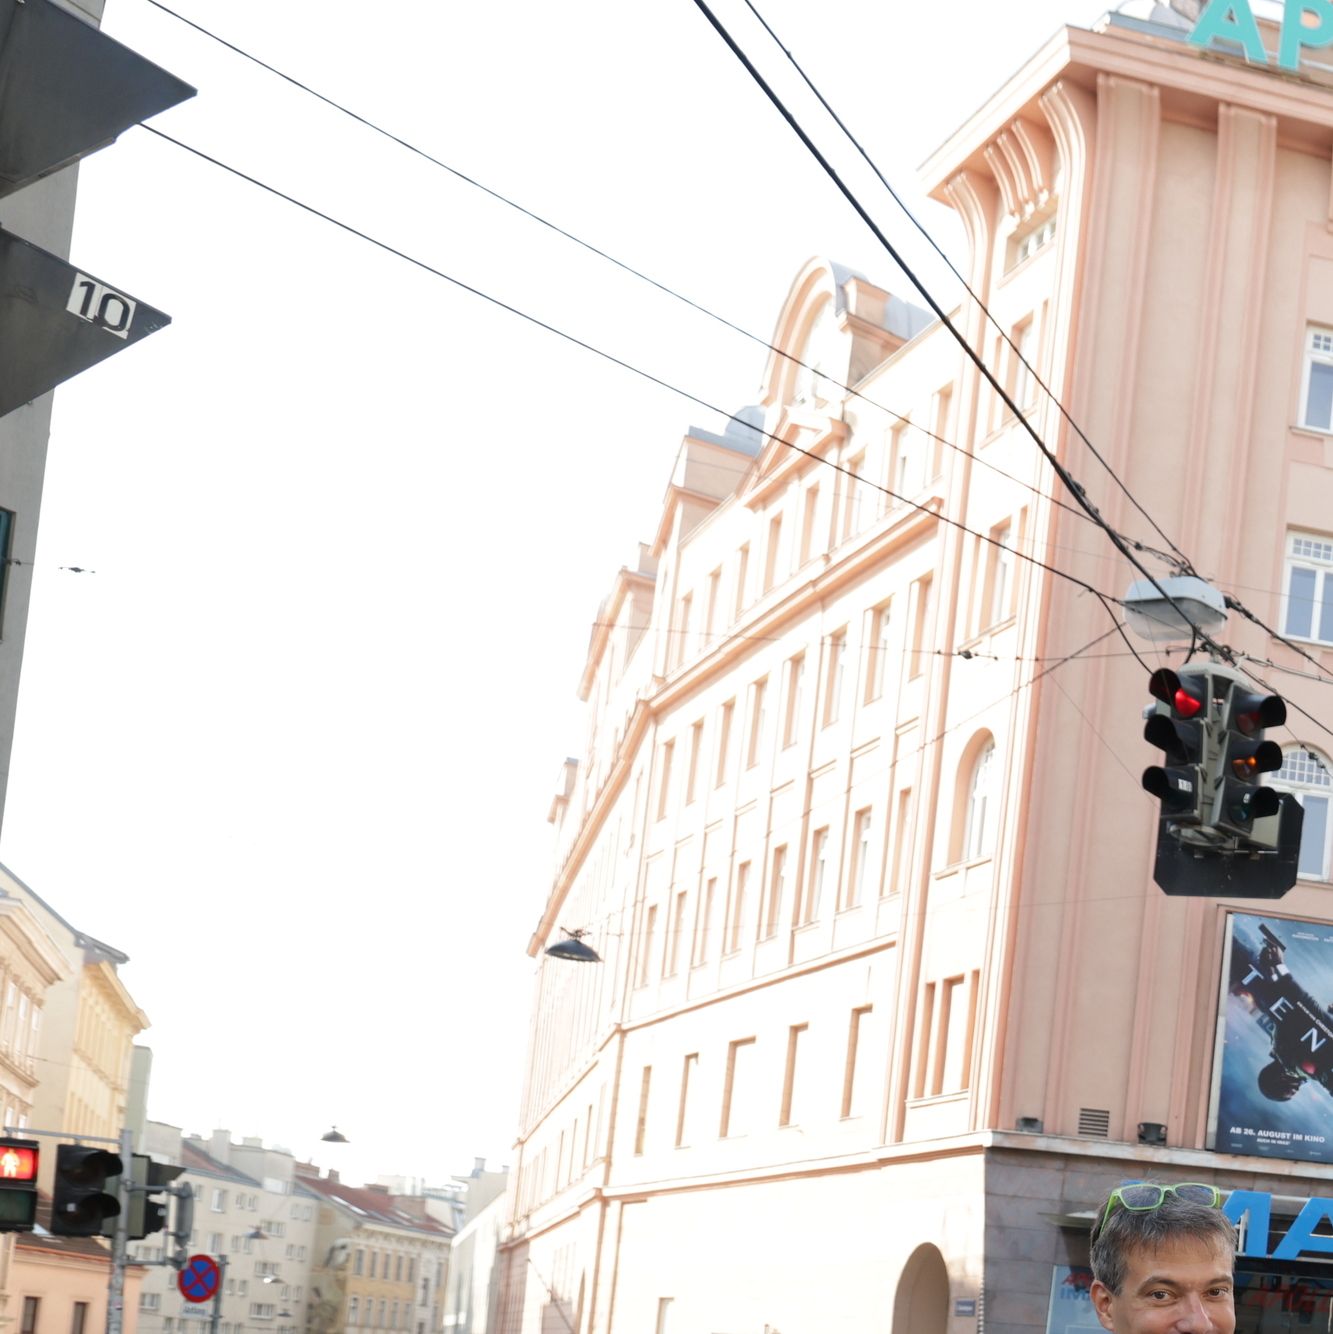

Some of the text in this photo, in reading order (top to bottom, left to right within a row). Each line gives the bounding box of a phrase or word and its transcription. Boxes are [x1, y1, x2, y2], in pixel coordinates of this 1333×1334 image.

[79, 281, 131, 332] 10
[1230, 1126, 1242, 1134] AB
[1257, 1130, 1291, 1139] AUGUST
[1293, 1133, 1303, 1141] IM
[1304, 1135, 1325, 1143] KINO
[1061, 1272, 1094, 1287] APO
